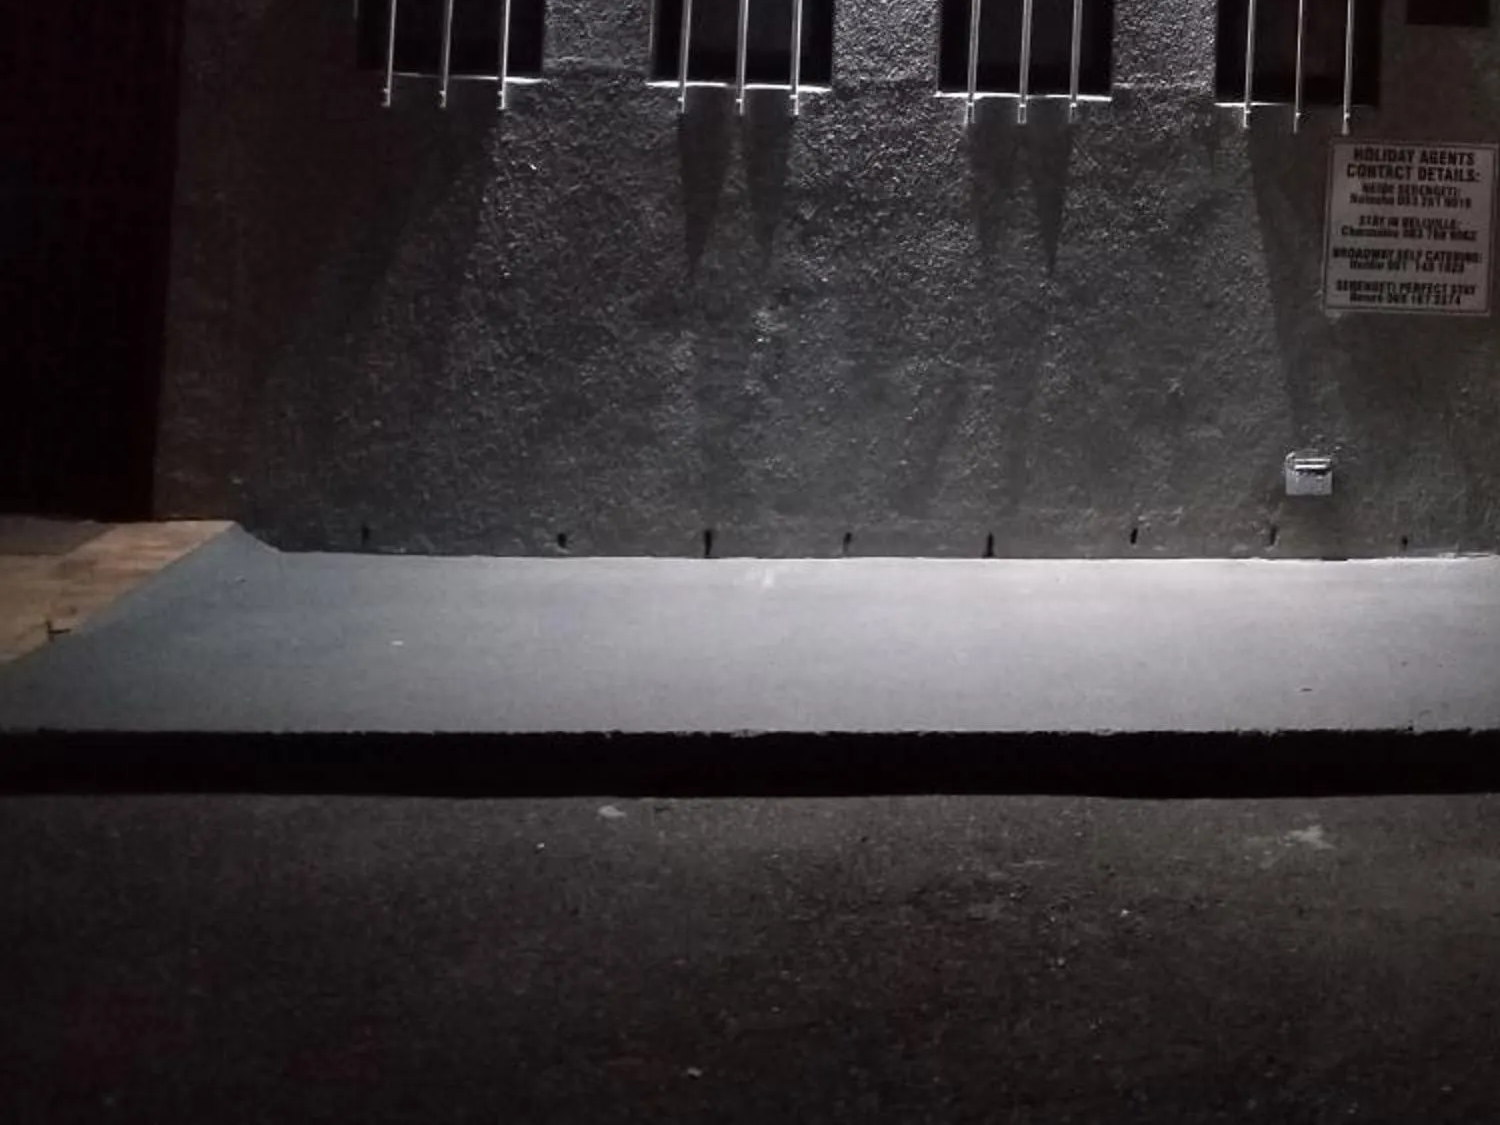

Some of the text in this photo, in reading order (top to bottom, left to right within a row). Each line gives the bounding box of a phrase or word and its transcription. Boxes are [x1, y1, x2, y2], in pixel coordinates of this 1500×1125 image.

[1353, 148, 1476, 166] HOLIDAY AGENTS
[1346, 164, 1412, 181] CONTACT
